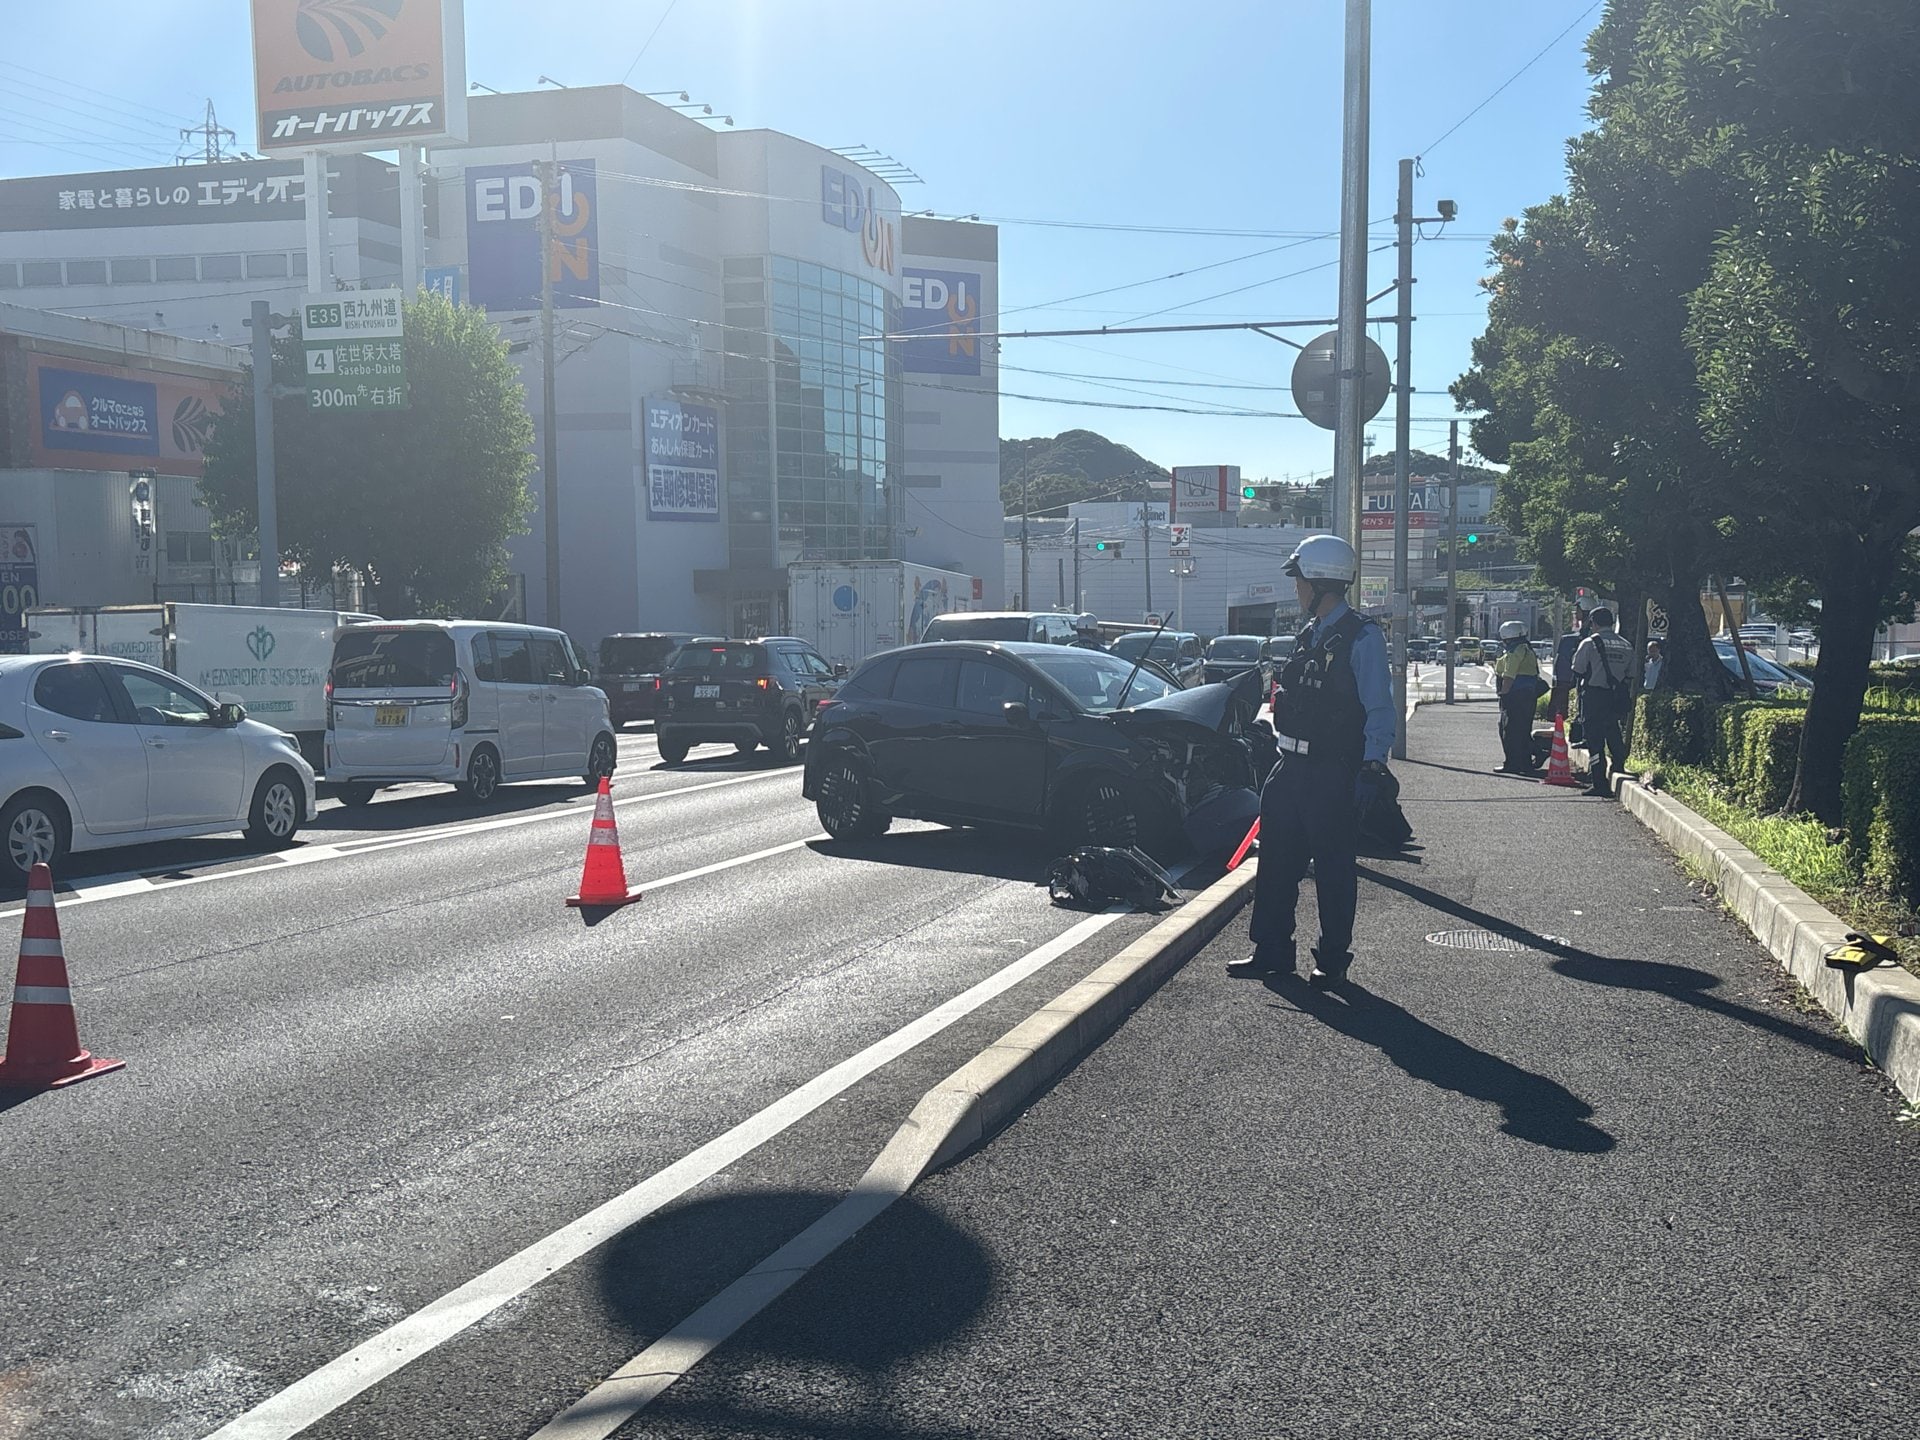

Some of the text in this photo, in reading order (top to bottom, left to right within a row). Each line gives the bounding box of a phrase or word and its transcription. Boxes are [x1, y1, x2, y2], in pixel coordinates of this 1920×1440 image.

[272, 63, 431, 95] AUTOBACS
[271, 102, 434, 138] オートバックス
[58, 186, 190, 210] 家電と暮らしの
[309, 308, 338, 324] E35
[343, 298, 397, 318] 西九州道
[902, 276, 977, 357] EDION
[387, 318, 398, 328] EXP
[314, 352, 327, 371] 4
[335, 342, 401, 362] 佐世保大塔
[338, 363, 401, 376] Sasebo-Daito
[91, 396, 144, 418] クルマのことなら
[90, 415, 149, 433] オートバックス
[650, 408, 714, 436] エディオンカード
[650, 436, 715, 460] あんしん保証カード
[652, 468, 716, 509] 長期修理保証
